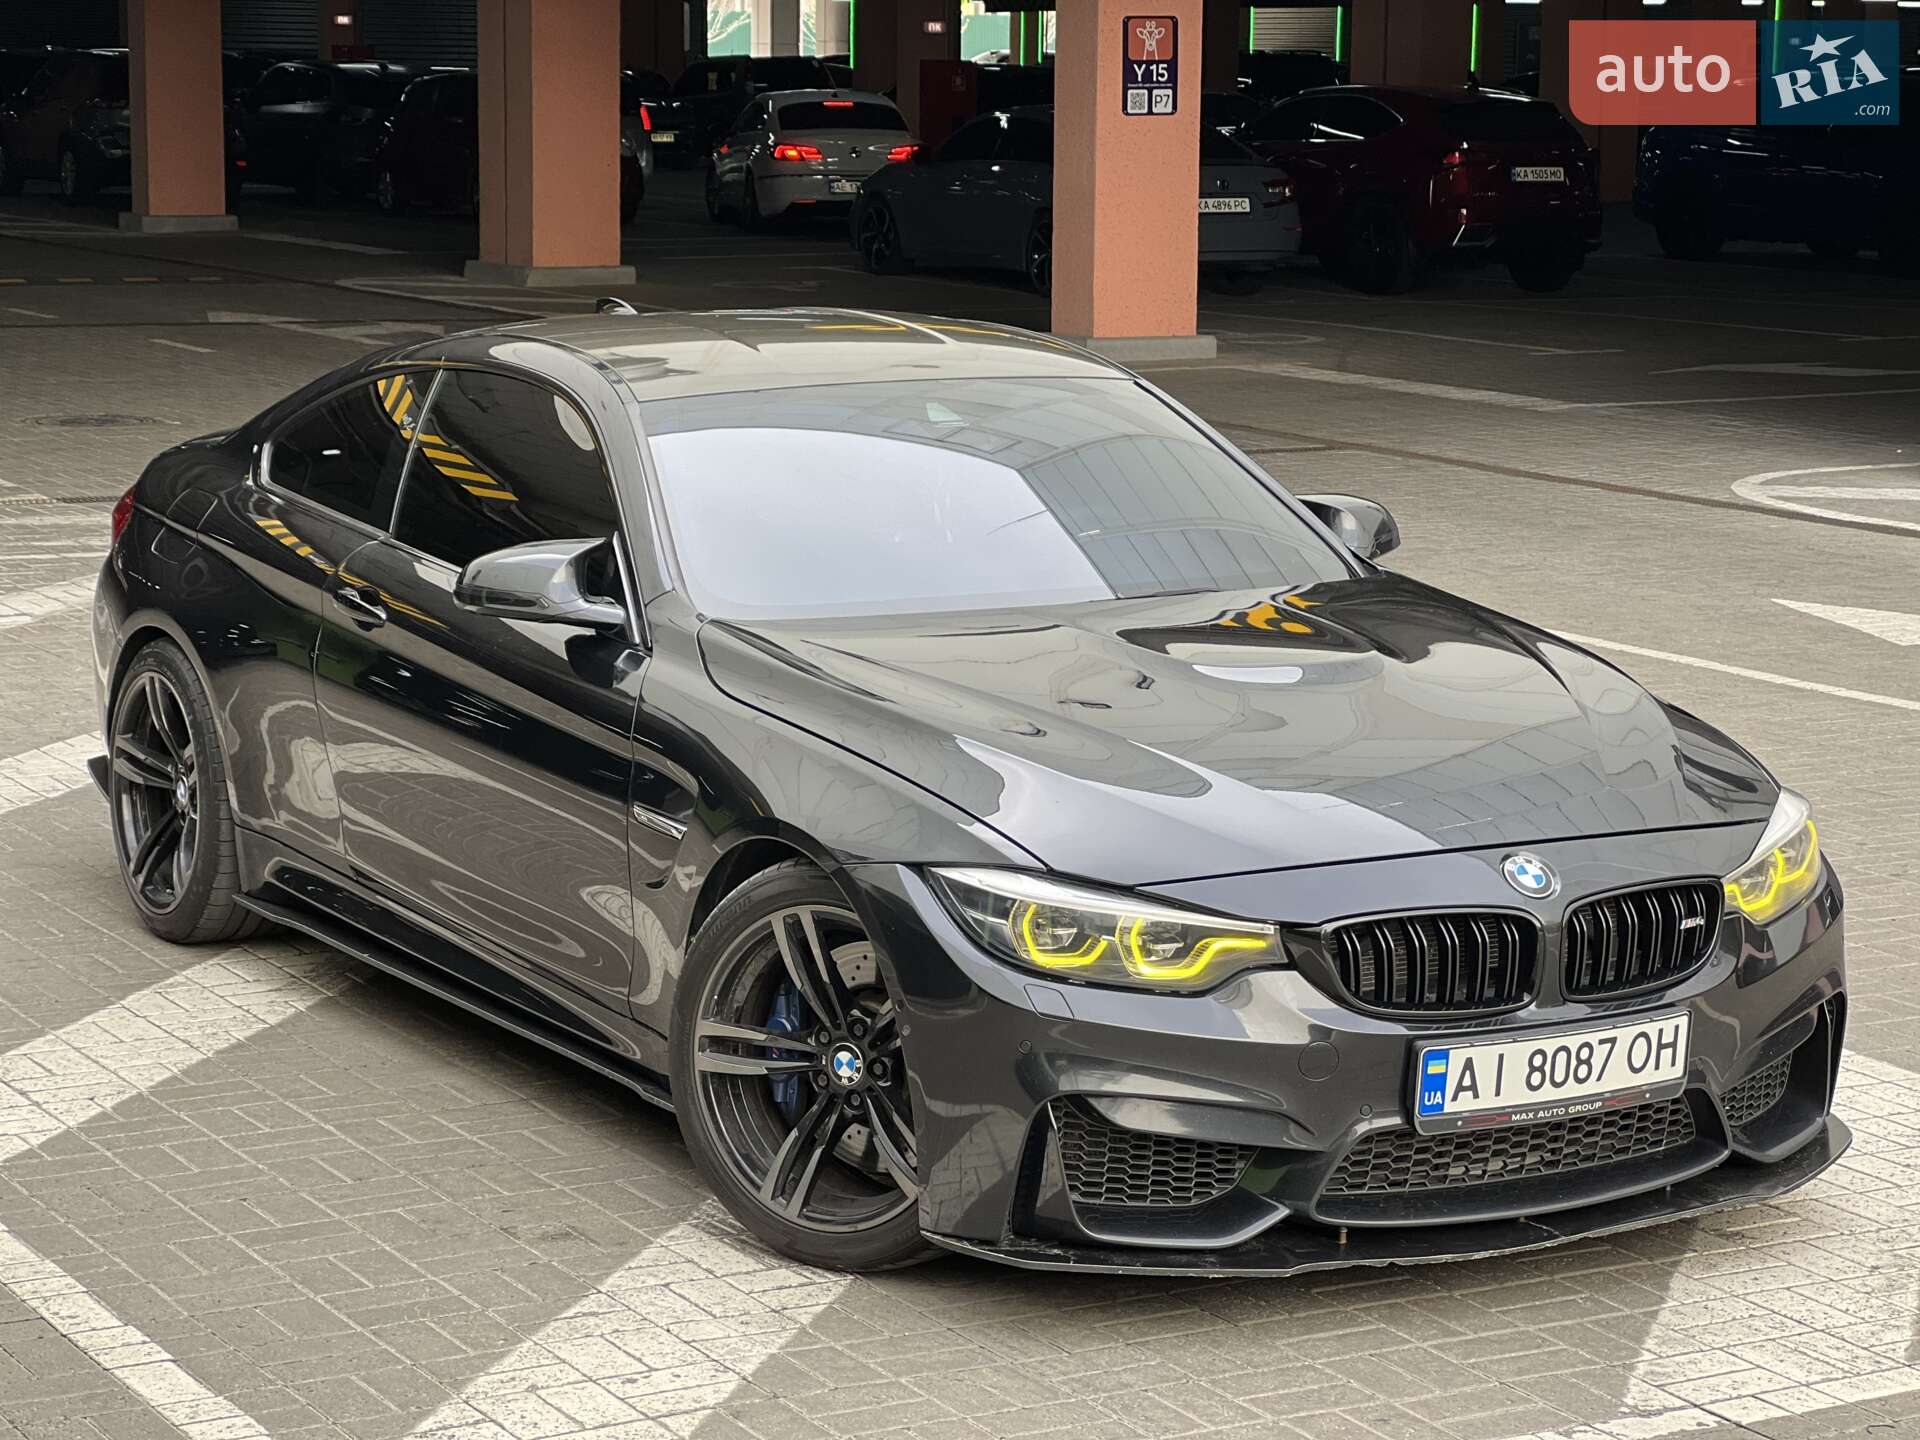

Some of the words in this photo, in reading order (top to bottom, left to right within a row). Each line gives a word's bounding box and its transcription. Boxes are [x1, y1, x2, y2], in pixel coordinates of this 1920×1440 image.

[1133, 63, 1146, 82] Y
[1149, 63, 1169, 82] 15
[1154, 94, 1170, 109] P7
[1212, 200, 1233, 210] 4896
[1233, 200, 1248, 210] PC
[1450, 1053, 1505, 1102] AI
[1525, 1036, 1618, 1092] 8087
[1626, 1024, 1680, 1075] OH
[1424, 1091, 1443, 1105] UA
[1511, 1111, 1535, 1122] MAX
[1537, 1106, 1566, 1118] AUTO
[1568, 1101, 1603, 1115] GROUP
